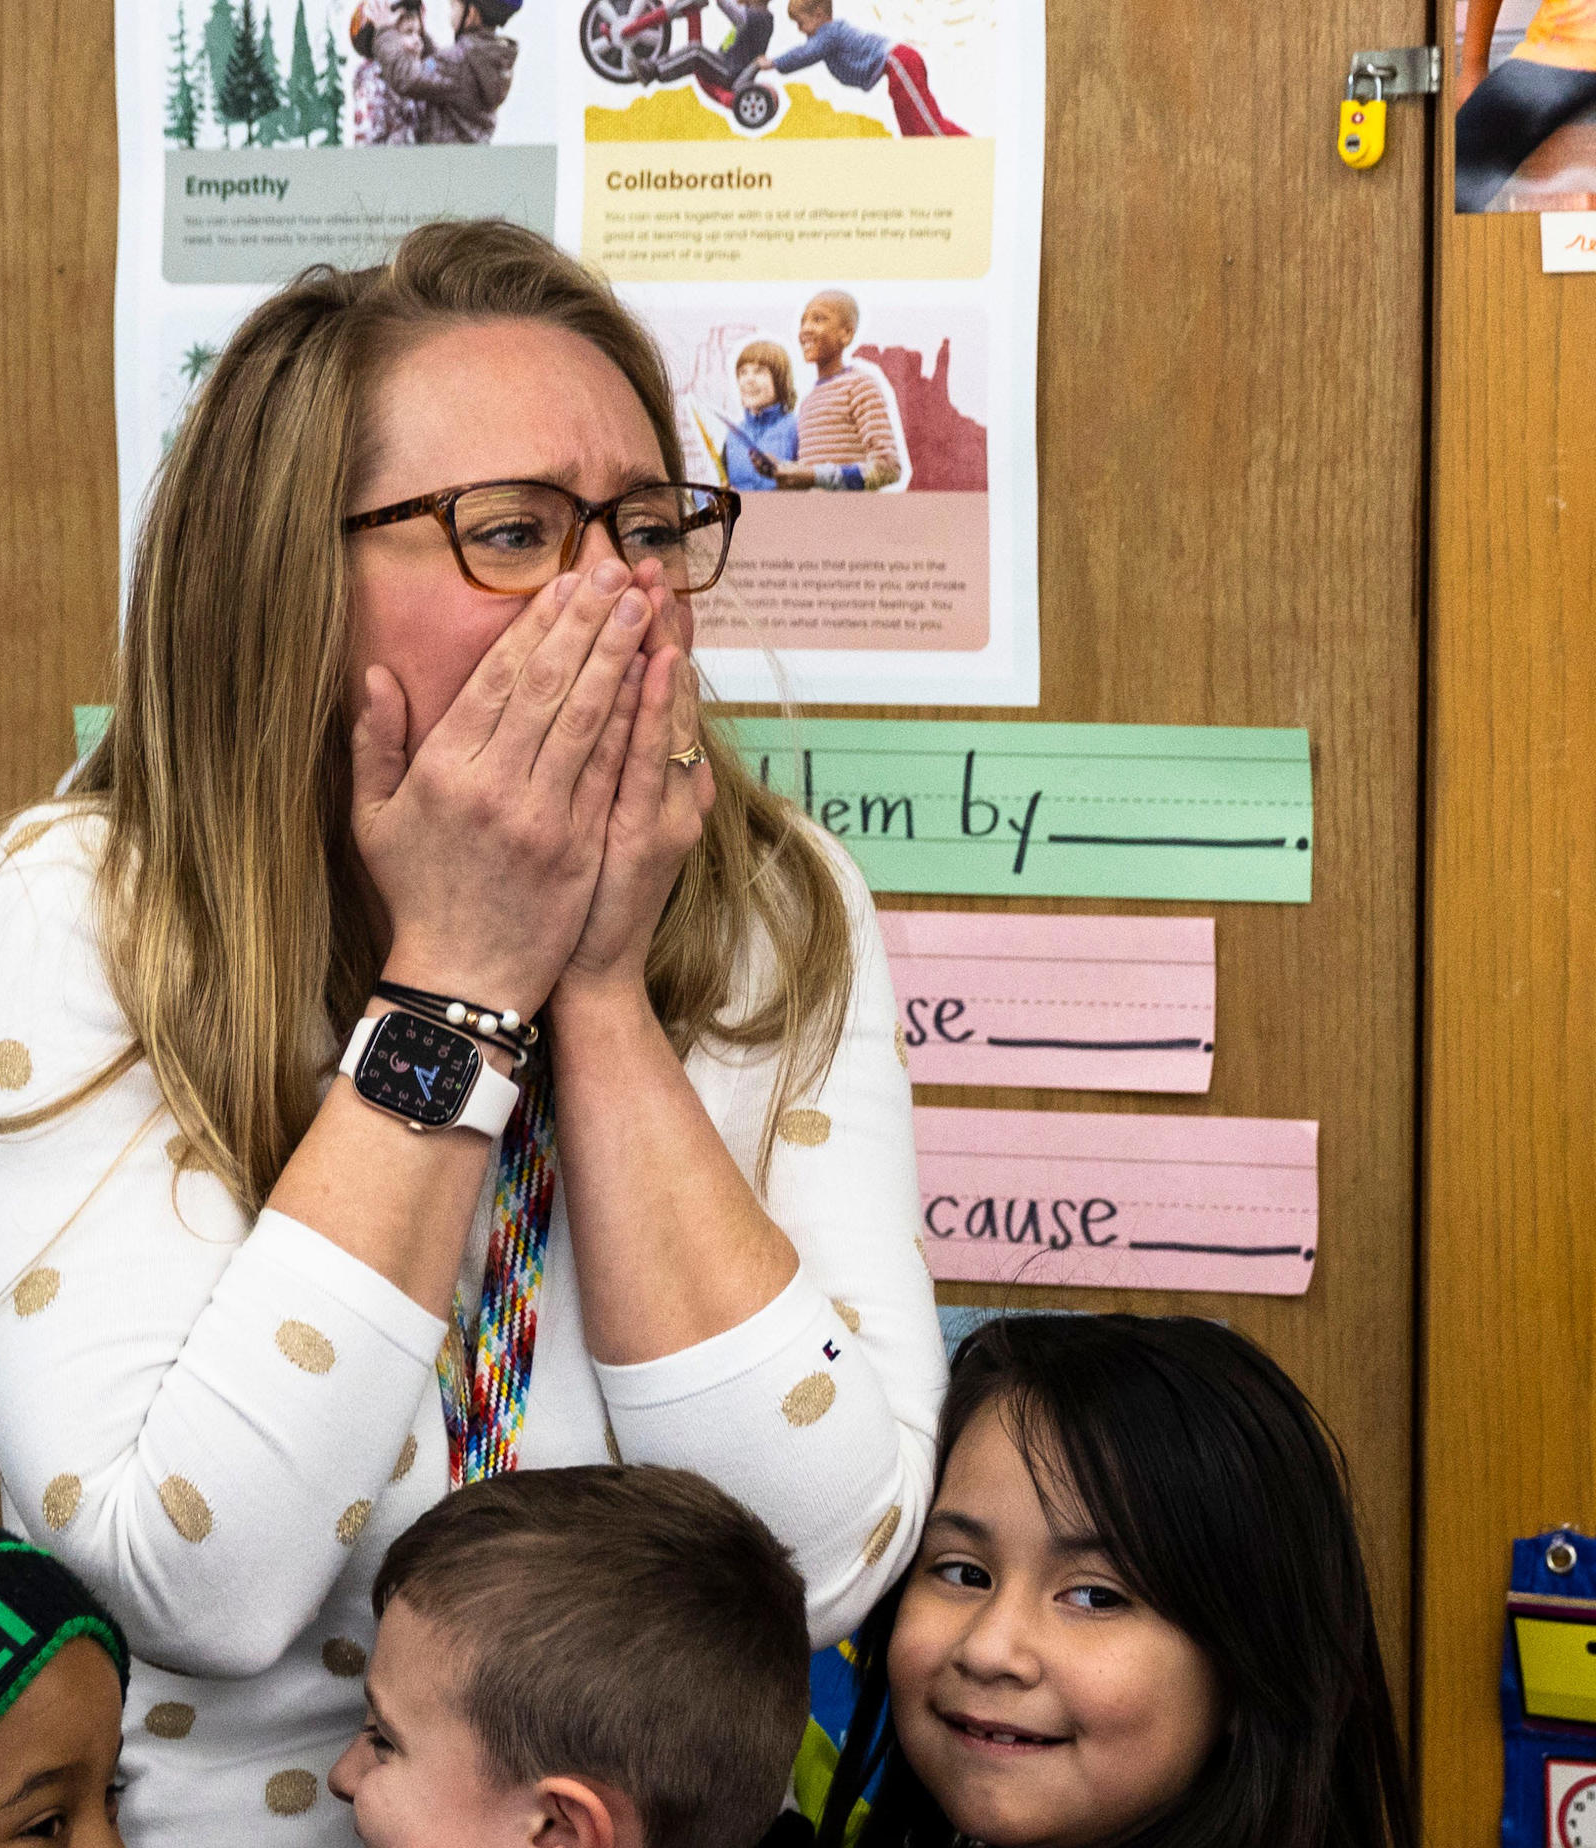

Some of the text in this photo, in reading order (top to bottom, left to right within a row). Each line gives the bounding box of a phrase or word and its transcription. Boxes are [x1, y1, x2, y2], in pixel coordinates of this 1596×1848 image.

[185, 174, 289, 201] Empathy
[607, 168, 772, 192] Collaboration
[905, 997, 975, 1046] se
[924, 1195, 1118, 1250] cause
